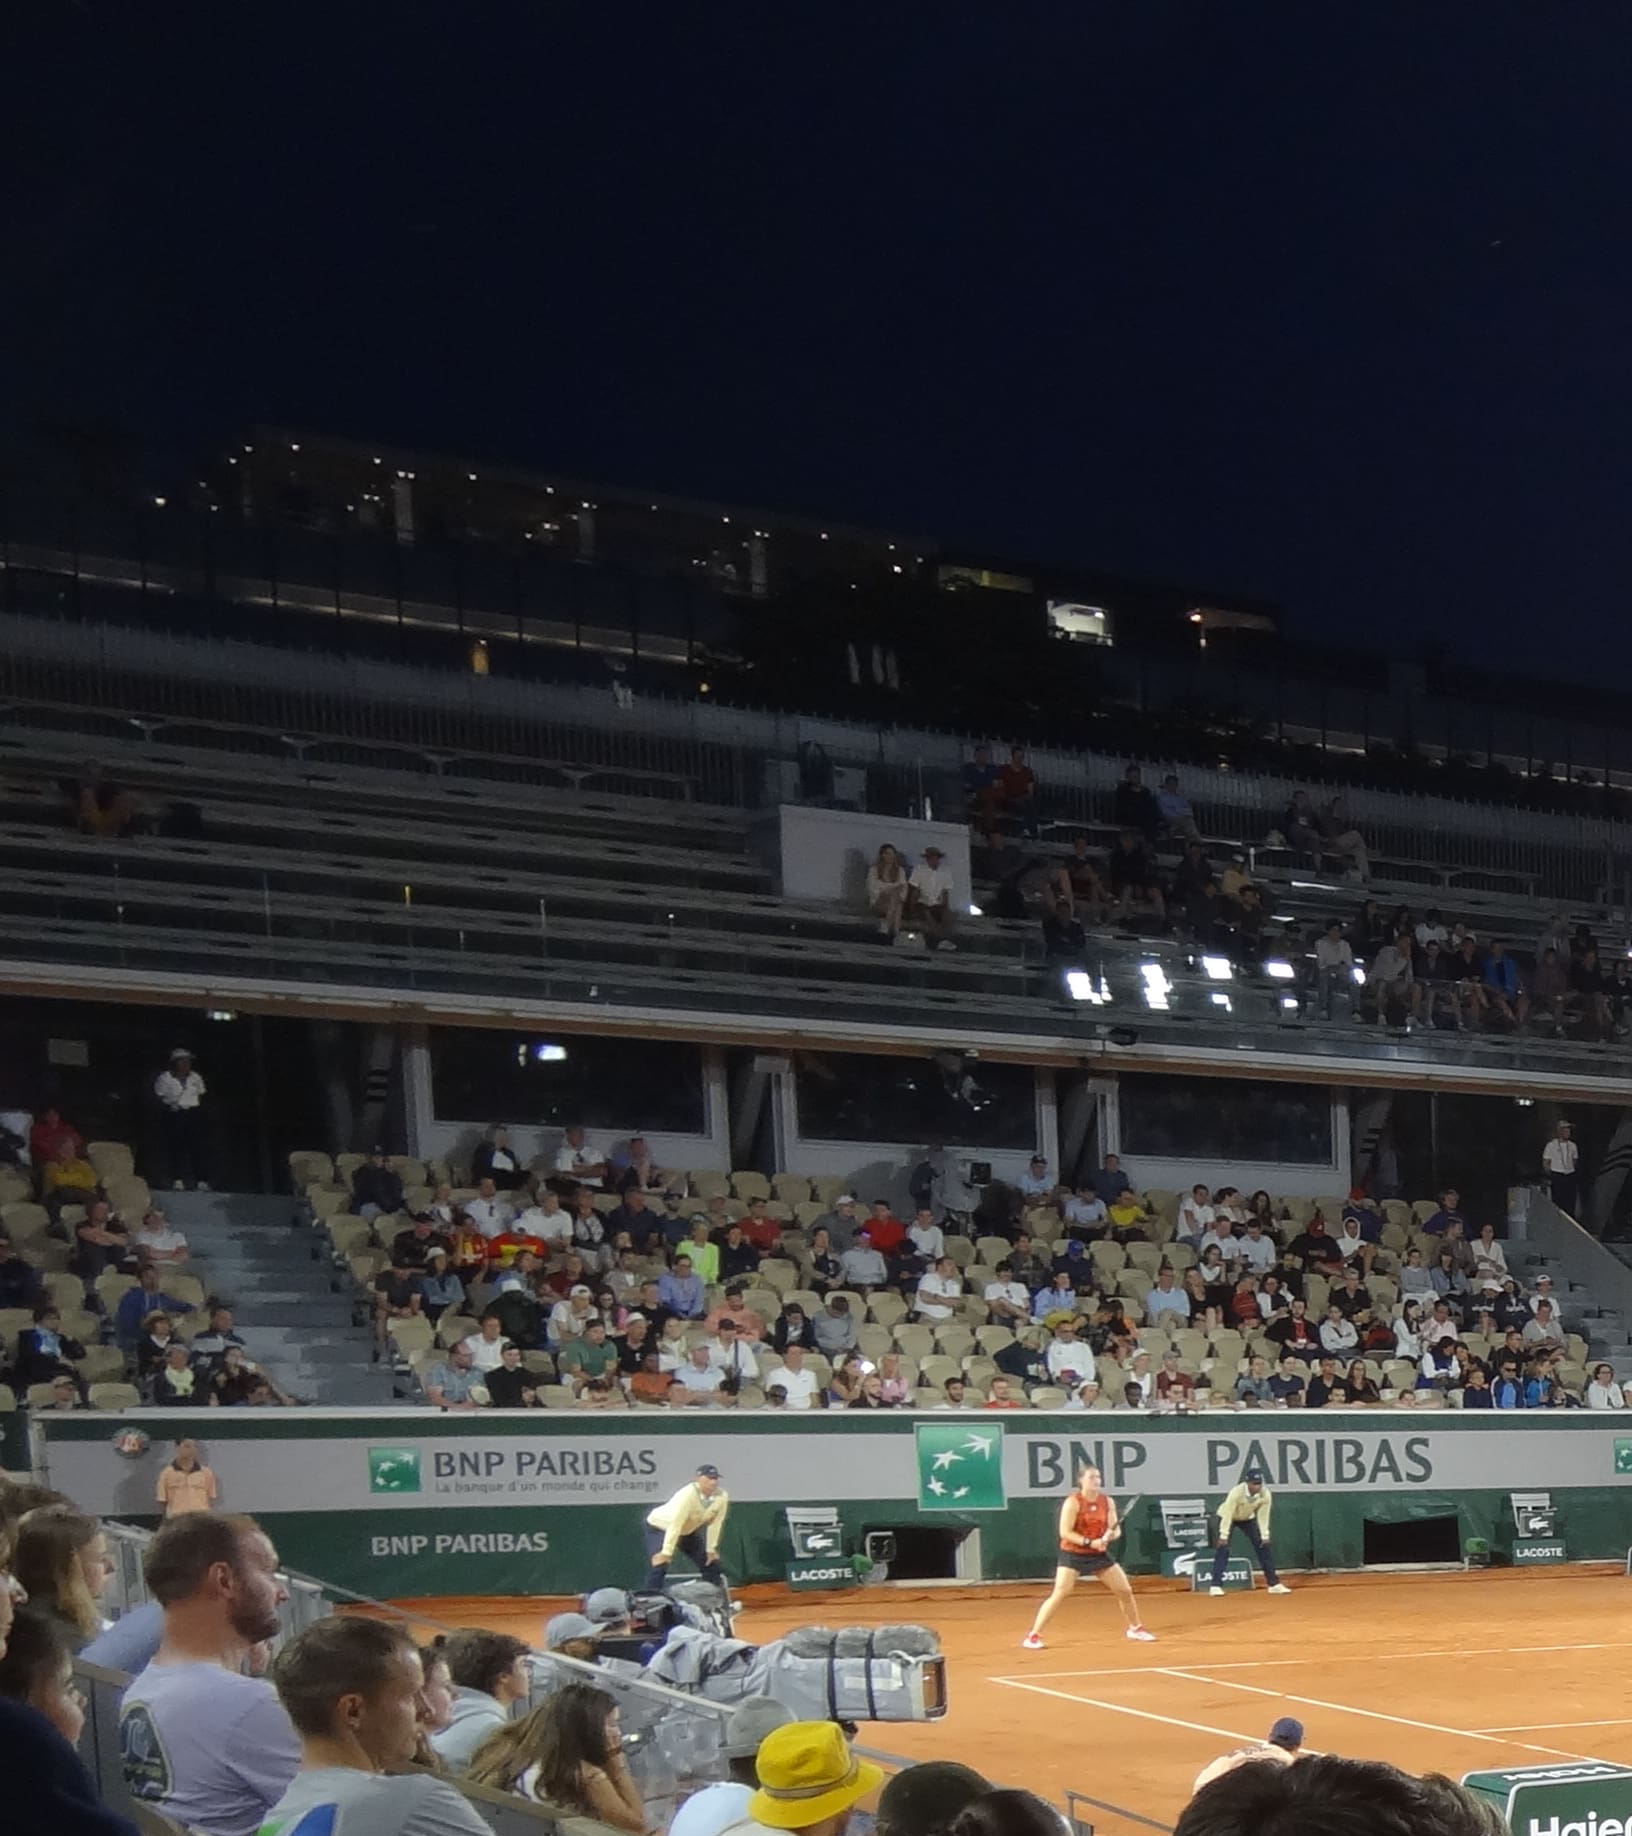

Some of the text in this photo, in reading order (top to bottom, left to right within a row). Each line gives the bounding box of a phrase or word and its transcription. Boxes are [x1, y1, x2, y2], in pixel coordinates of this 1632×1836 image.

[434, 1449, 657, 1478] BNP PARIBAS
[1027, 1437, 1433, 1489] BNP PARIBAS
[435, 1479, 659, 1495] La banque d'un monde qui change
[1174, 1528, 1206, 1537] LACOSTE
[371, 1532, 549, 1556] BNP PARIBAS
[1516, 1547, 1563, 1558] LACOSTE
[791, 1568, 854, 1582] LACOSTE
[1197, 1571, 1249, 1582] LAOSTE
